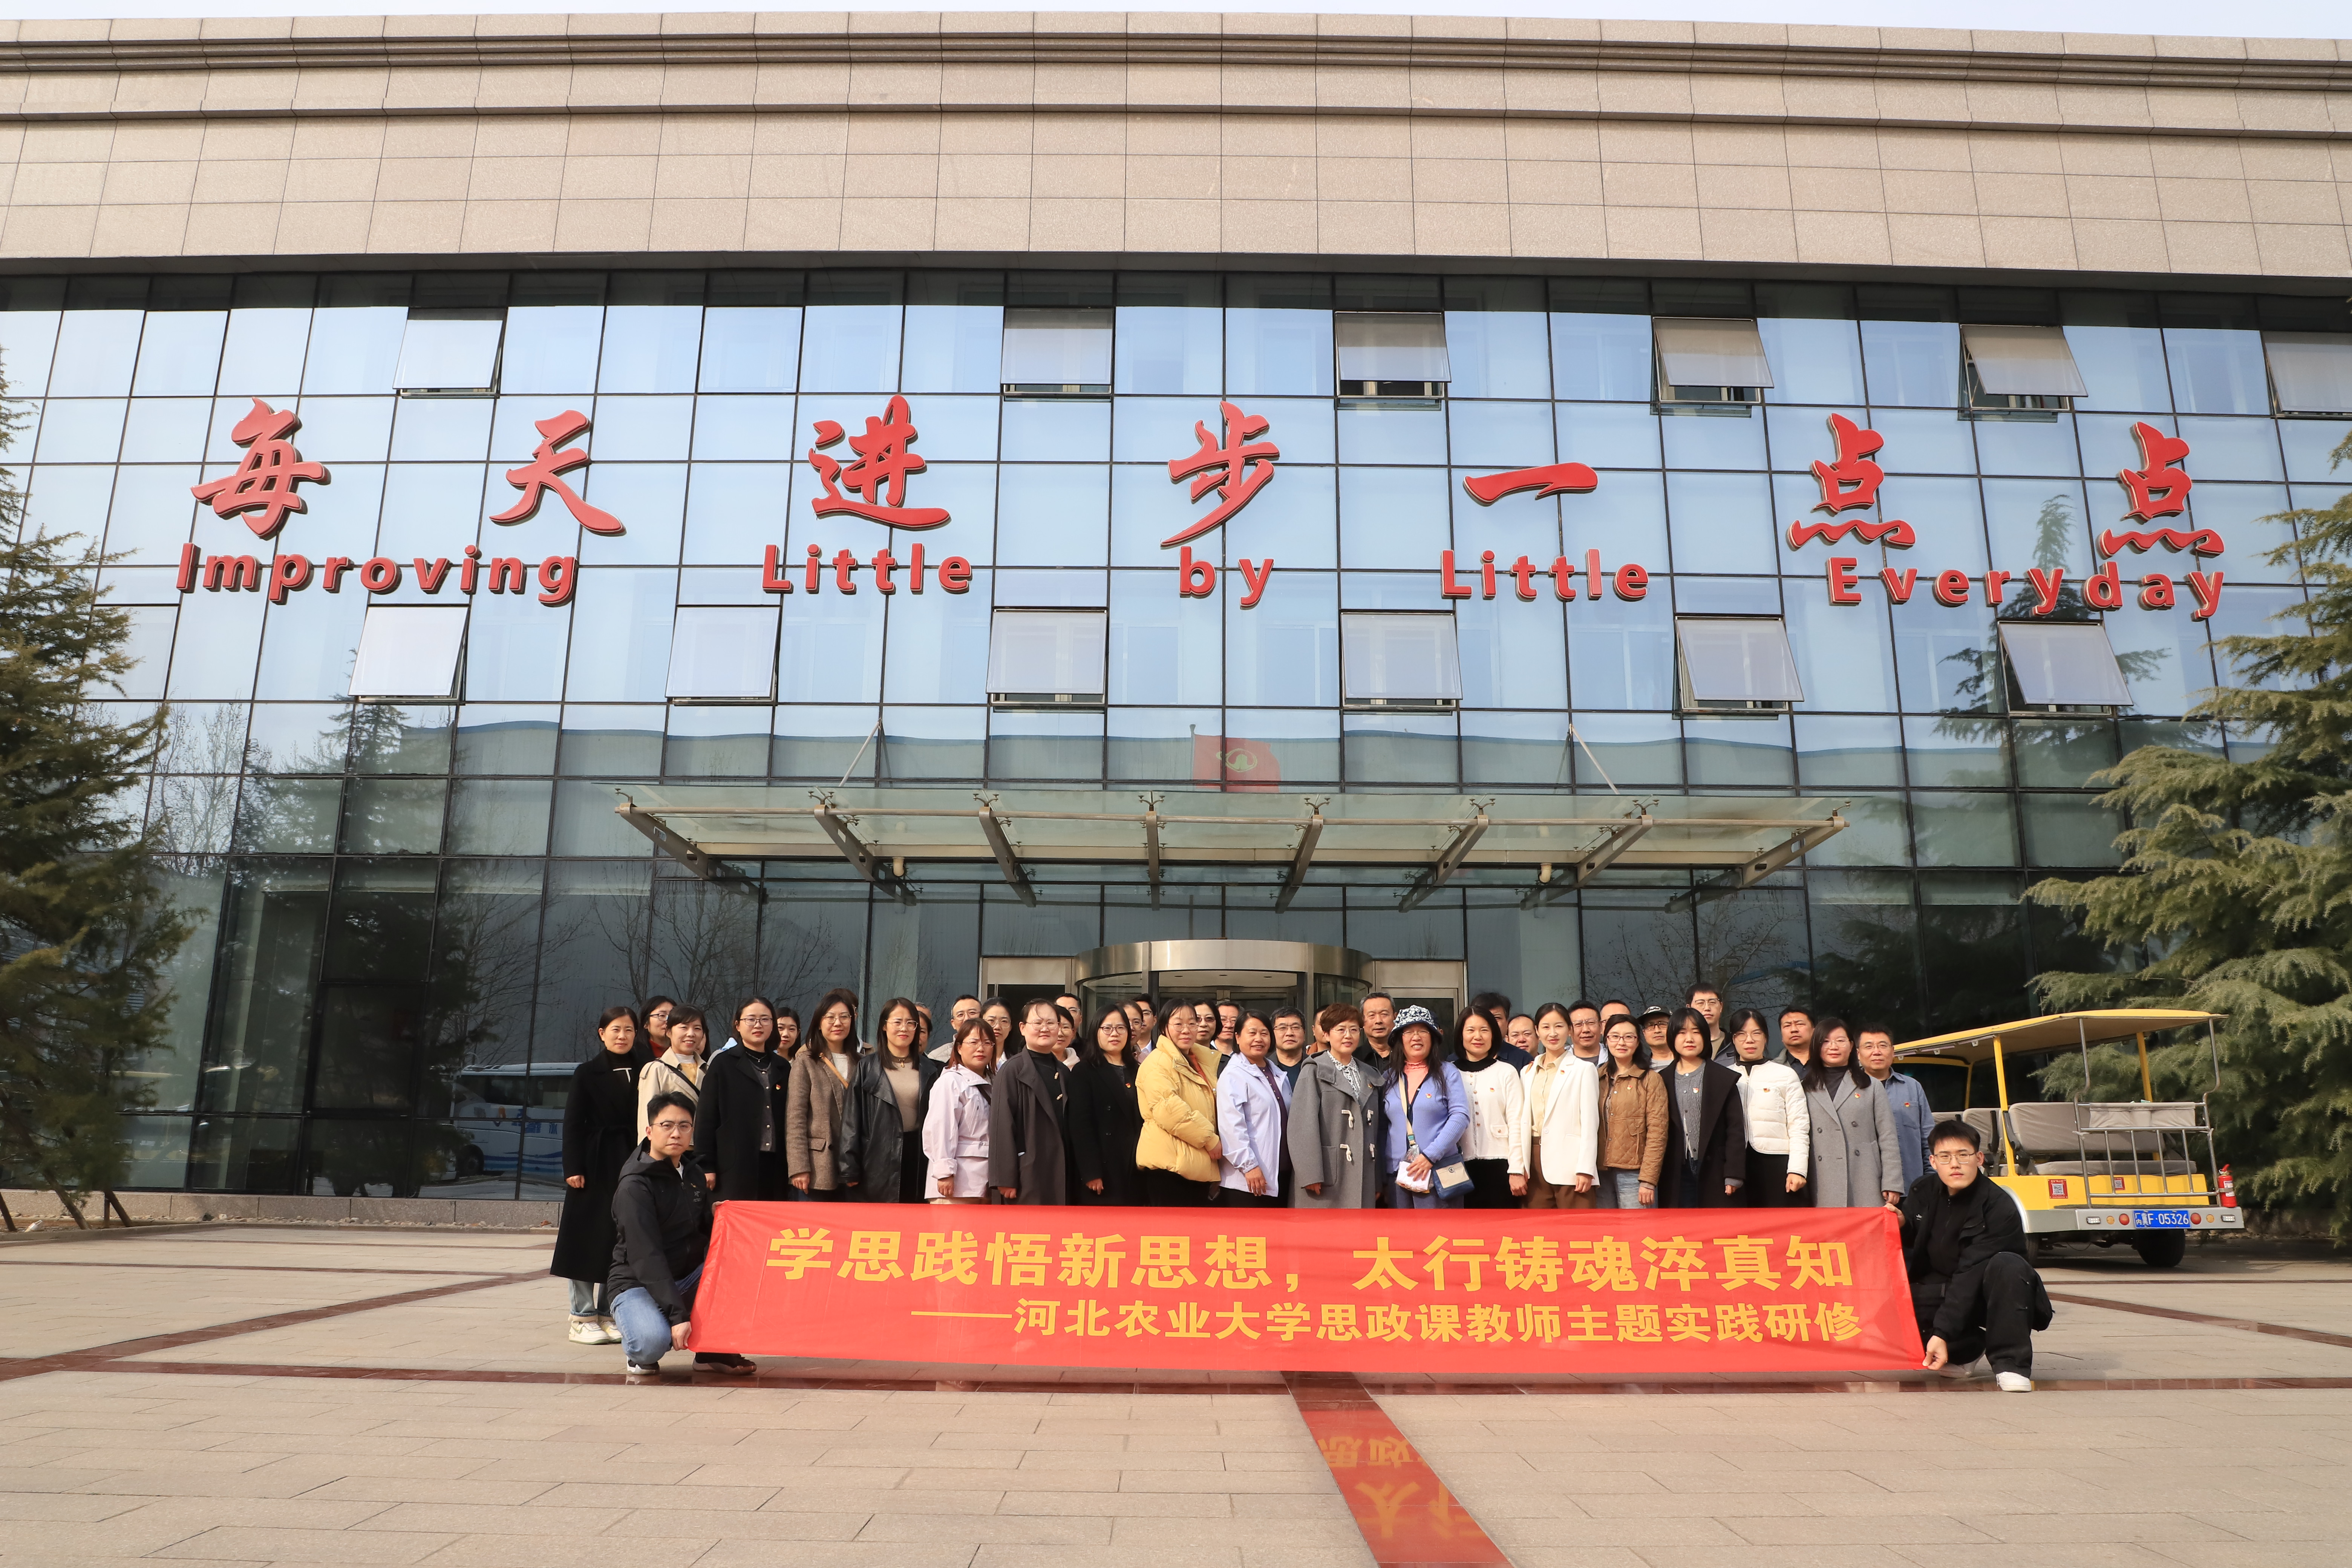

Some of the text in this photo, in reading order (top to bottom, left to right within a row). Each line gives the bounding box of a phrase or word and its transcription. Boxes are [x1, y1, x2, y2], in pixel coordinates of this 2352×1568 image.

[176, 543, 2225, 620] Improving Little by Little Everyday
[766, 1227, 1854, 1293] 学思践悟新思想， 太行铸魂淬真知
